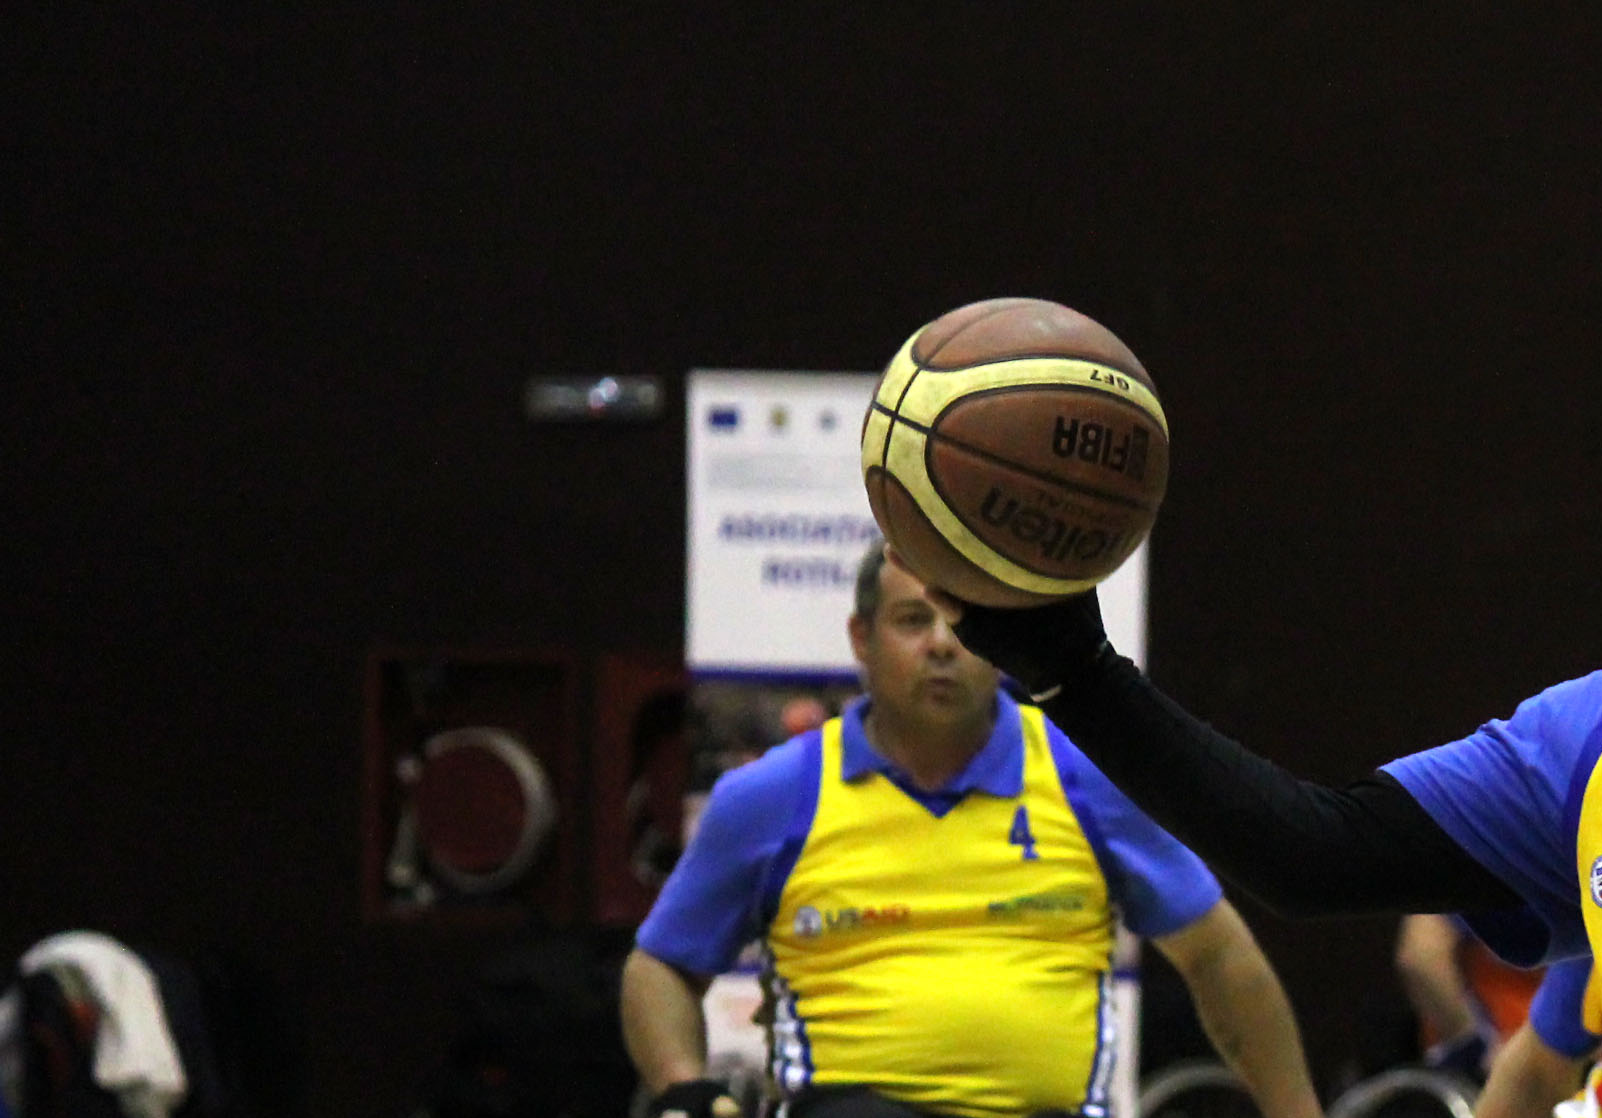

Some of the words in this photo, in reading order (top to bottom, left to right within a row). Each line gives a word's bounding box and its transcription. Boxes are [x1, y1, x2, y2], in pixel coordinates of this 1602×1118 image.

[1089, 369, 1130, 390] GF7
[1052, 415, 1131, 473] FIBA
[1008, 804, 1039, 861] 4
